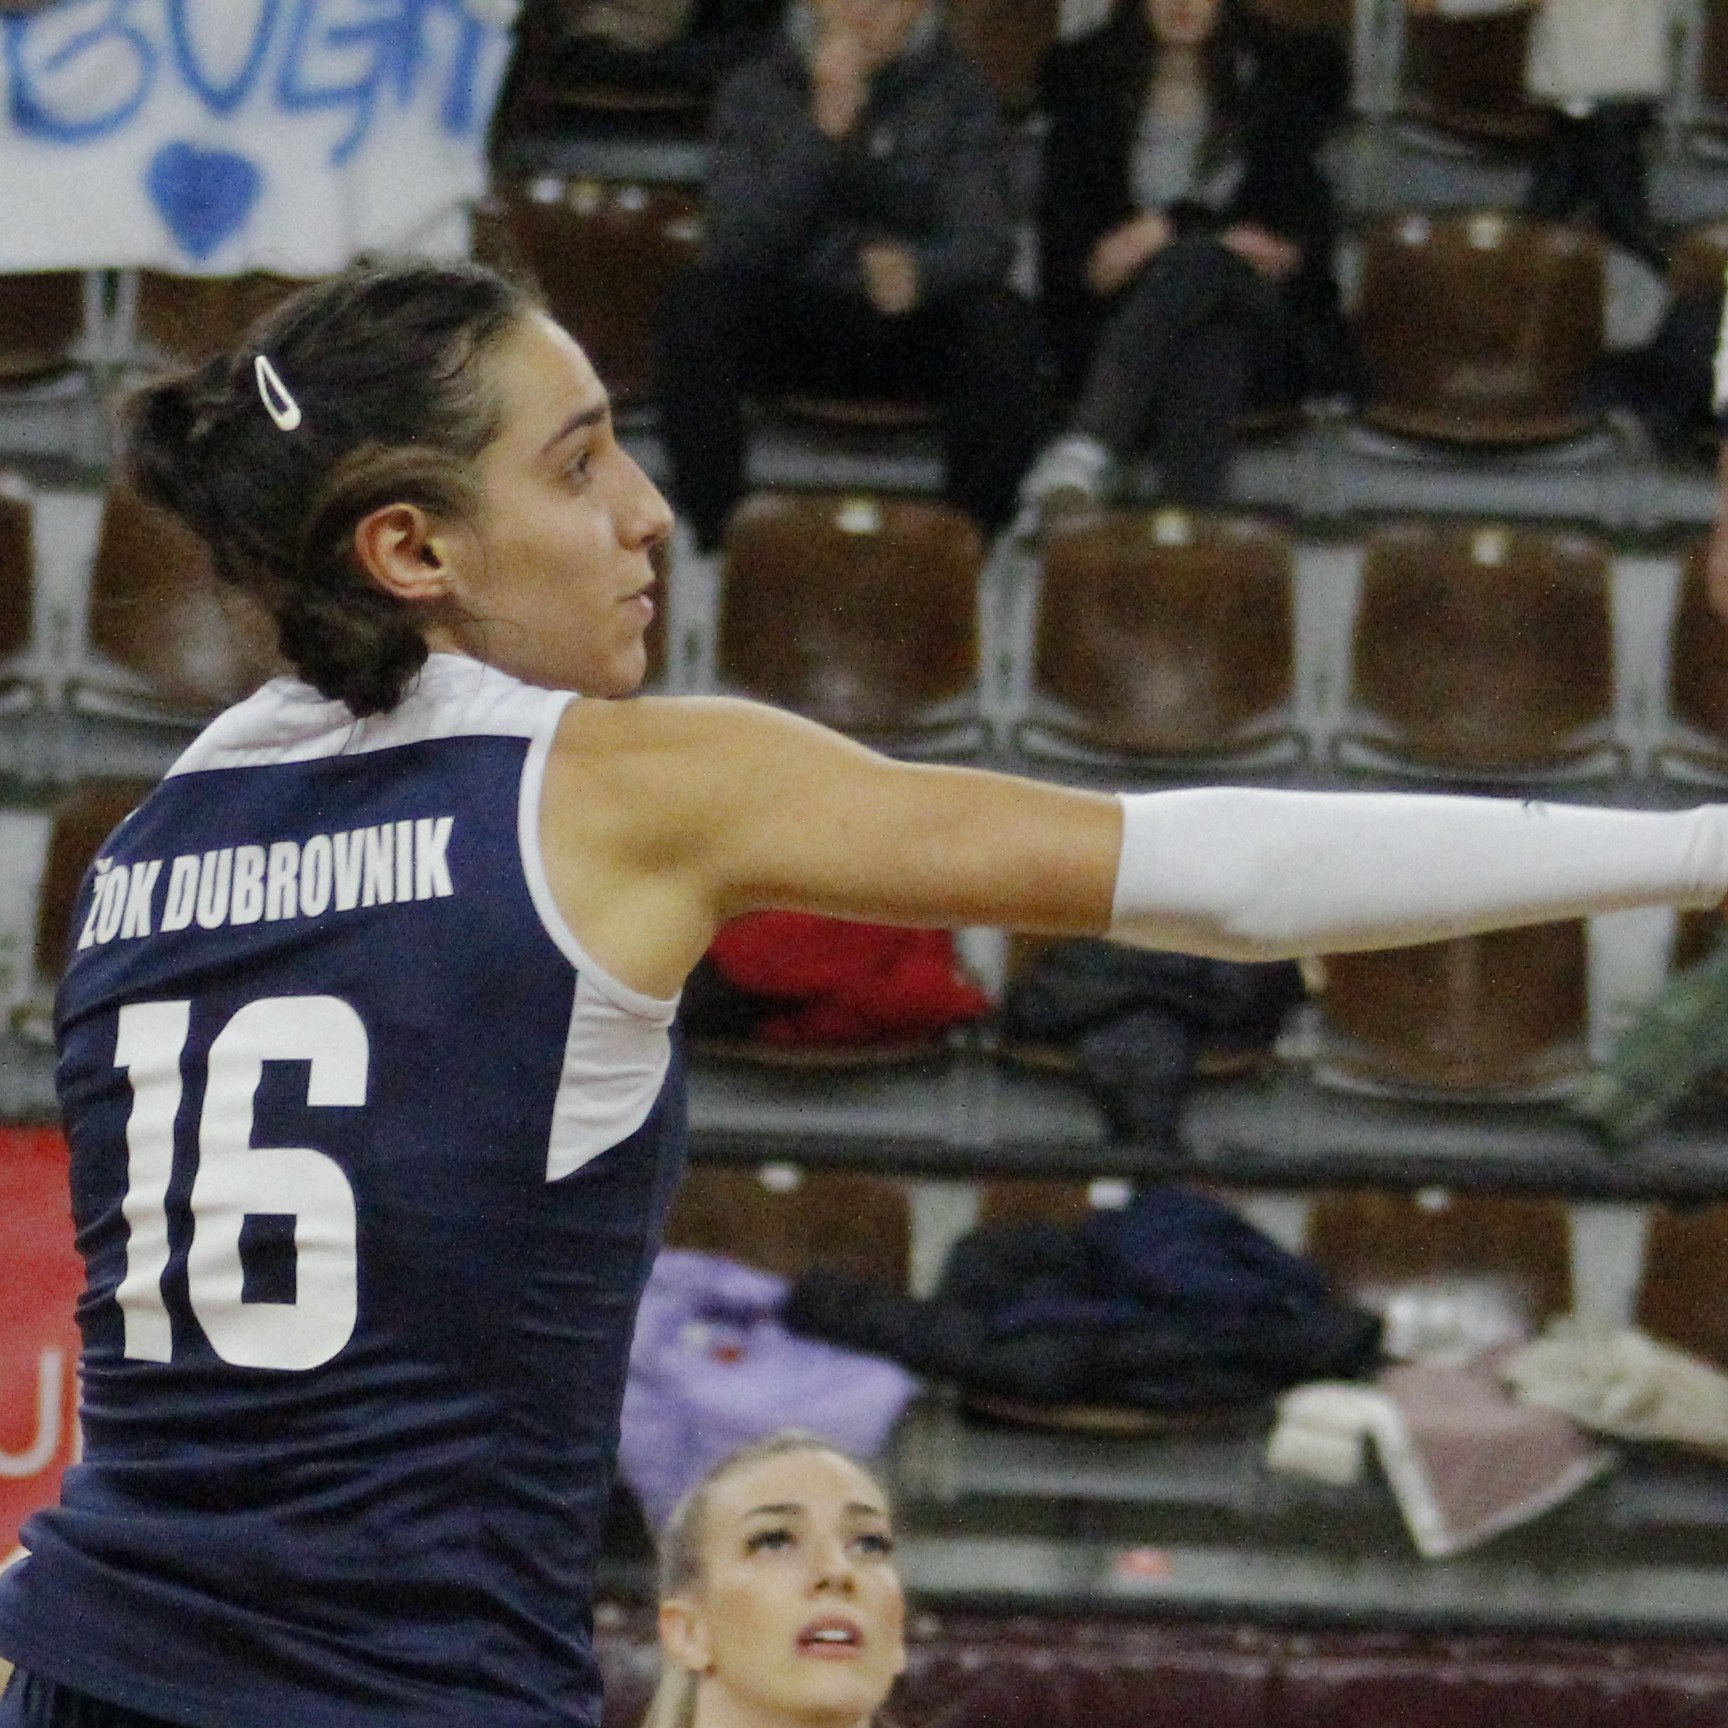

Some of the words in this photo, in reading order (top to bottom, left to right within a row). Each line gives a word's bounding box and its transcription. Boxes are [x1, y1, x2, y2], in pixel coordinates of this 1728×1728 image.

[77, 857, 163, 950] ŽOK
[160, 816, 456, 933] DUBROVNIK
[114, 995, 370, 1370] 16
